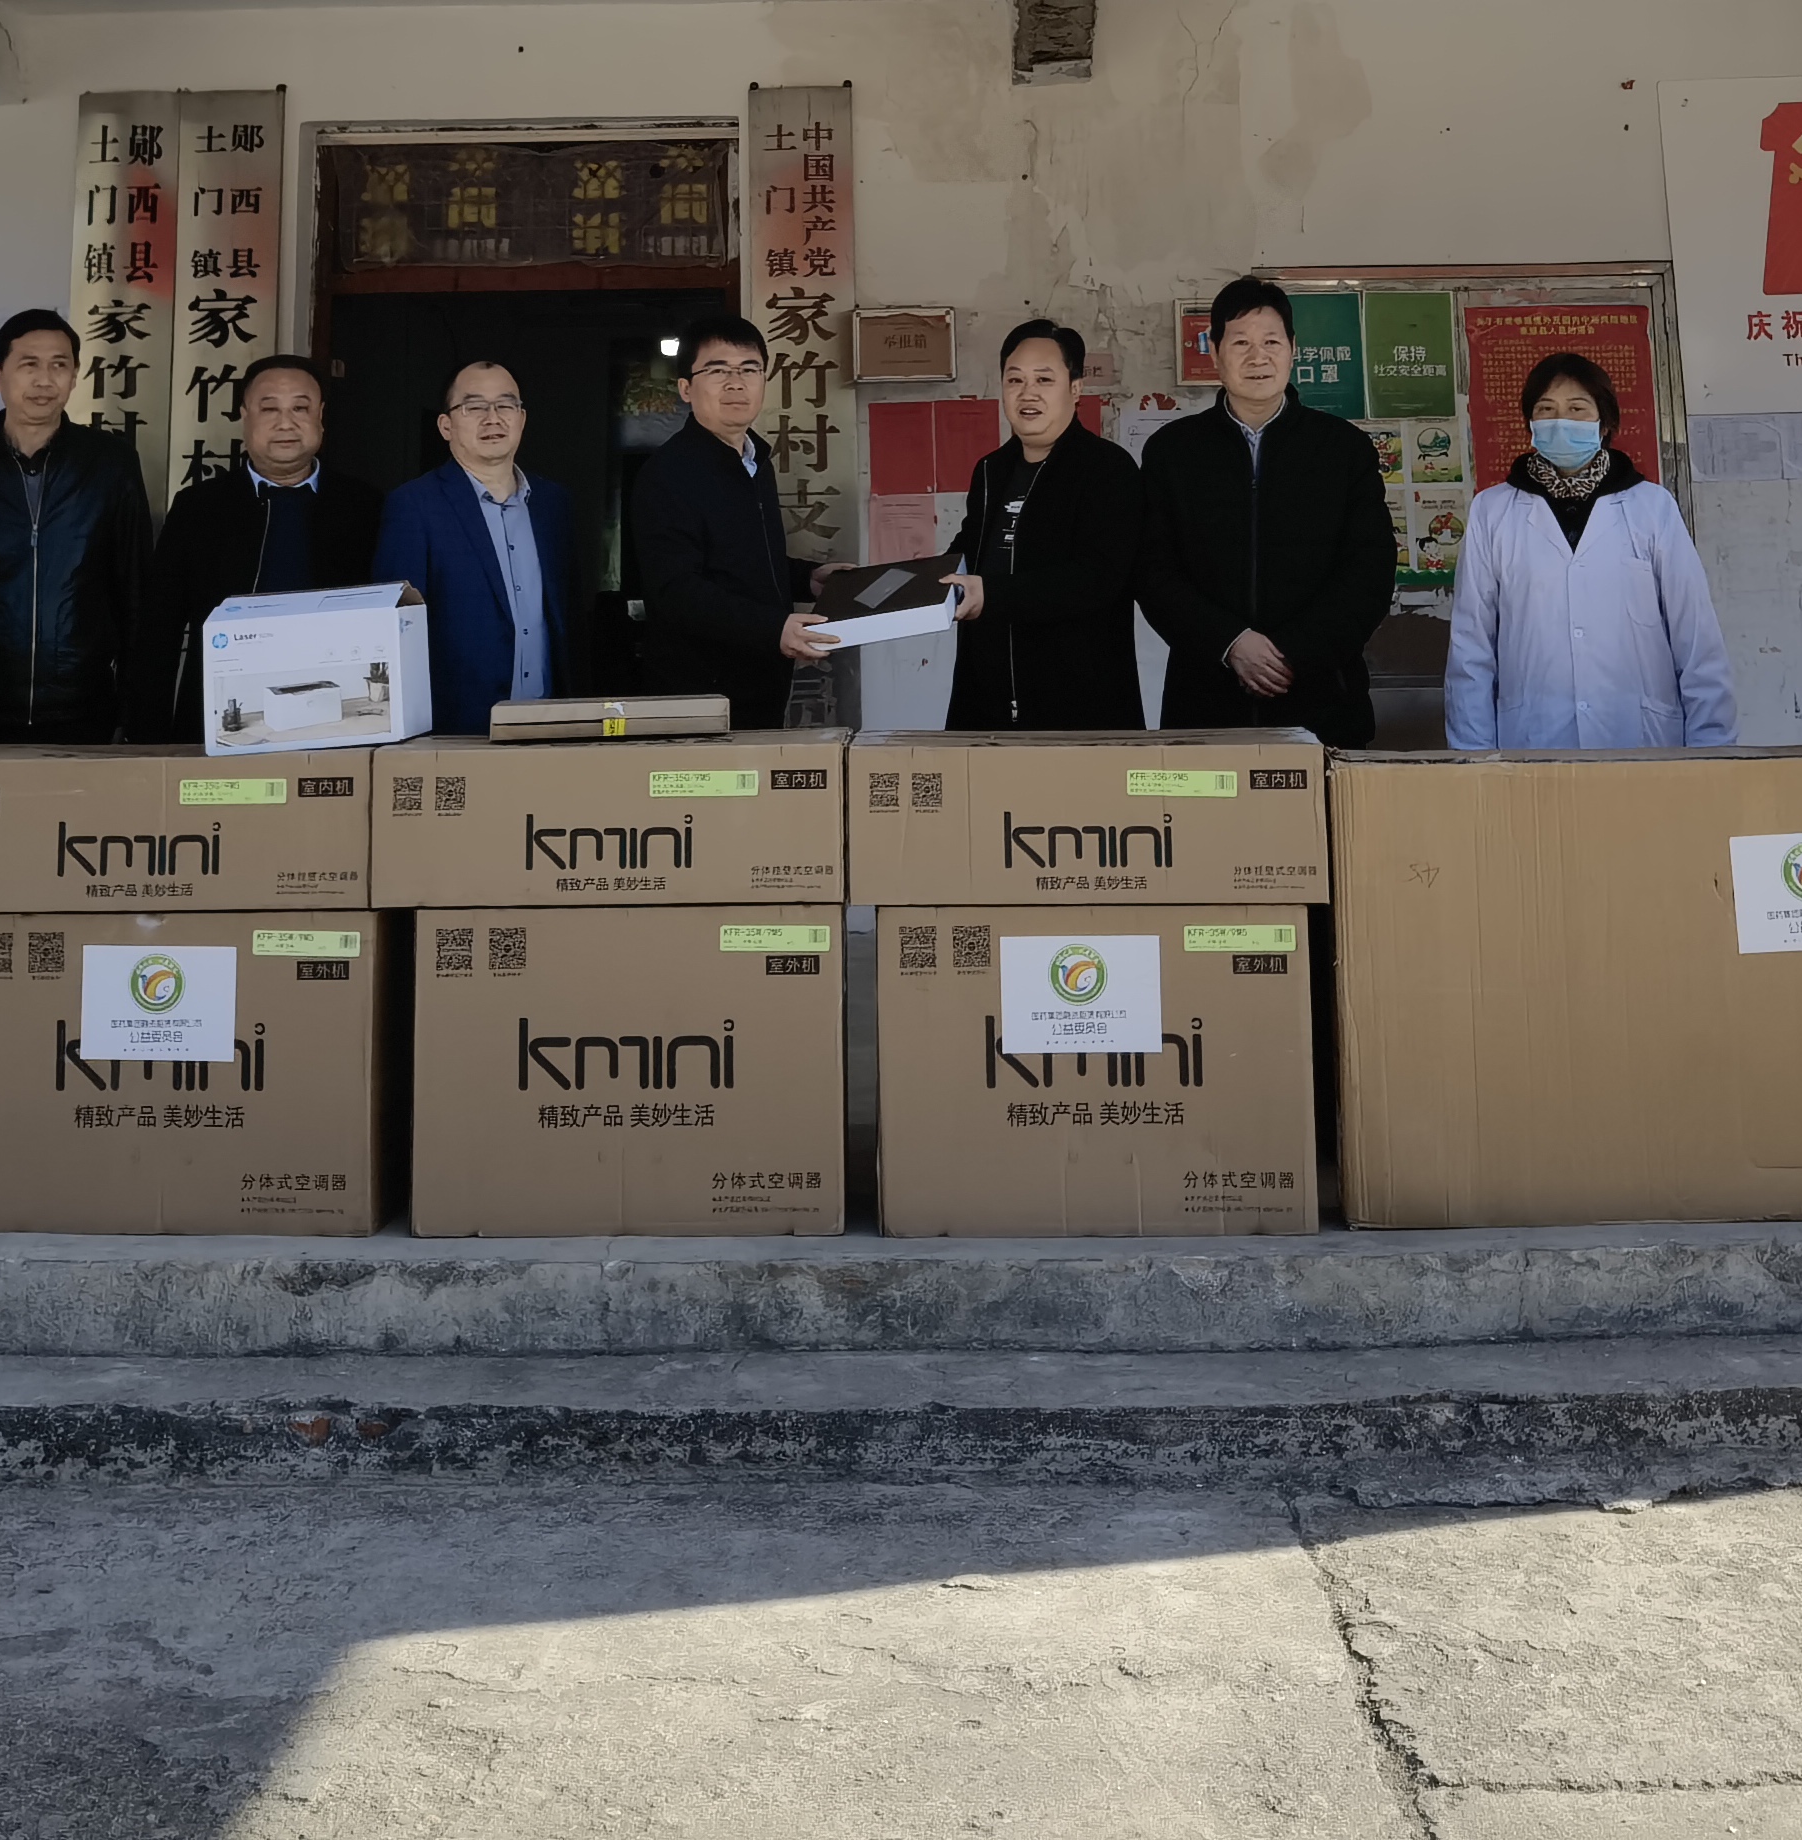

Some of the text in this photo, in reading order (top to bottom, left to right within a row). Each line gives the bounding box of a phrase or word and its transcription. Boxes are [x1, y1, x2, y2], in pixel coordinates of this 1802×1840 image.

[84, 124, 120, 284] 土门镇
[123, 124, 164, 284] 郧西县
[191, 125, 227, 279] 土门镇
[226, 124, 265, 279] 郧西县
[763, 124, 798, 277] 土门镇
[802, 121, 837, 278] 中国共产党
[1393, 345, 1427, 363] 保持
[1297, 363, 1340, 384] 口罩
[1374, 363, 1448, 378] 社交安全距离
[764, 286, 840, 556] 家竹村支
[300, 779, 352, 796] 室内机
[773, 771, 825, 788] 室内机
[1252, 771, 1305, 789] 室内机
[86, 882, 195, 898] 精致产品 美妙生活
[555, 875, 667, 892] 精致产品 美妙生活
[1035, 875, 1148, 891] 精致产品 美妙生活
[299, 962, 348, 979] 室外机
[768, 956, 817, 973] 室外机
[1235, 956, 1285, 973] 室外机
[518, 1017, 735, 1091] kmini
[74, 1104, 246, 1129] 精致产品 美妙生活
[537, 1103, 716, 1129] 精致产品 美妙生活
[1006, 1101, 1185, 1127] 精致产品 美妙生活
[240, 1173, 347, 1192] 分体式空调器
[711, 1171, 823, 1191] 分体式空调器
[1182, 1170, 1295, 1190] 分体式空调器
